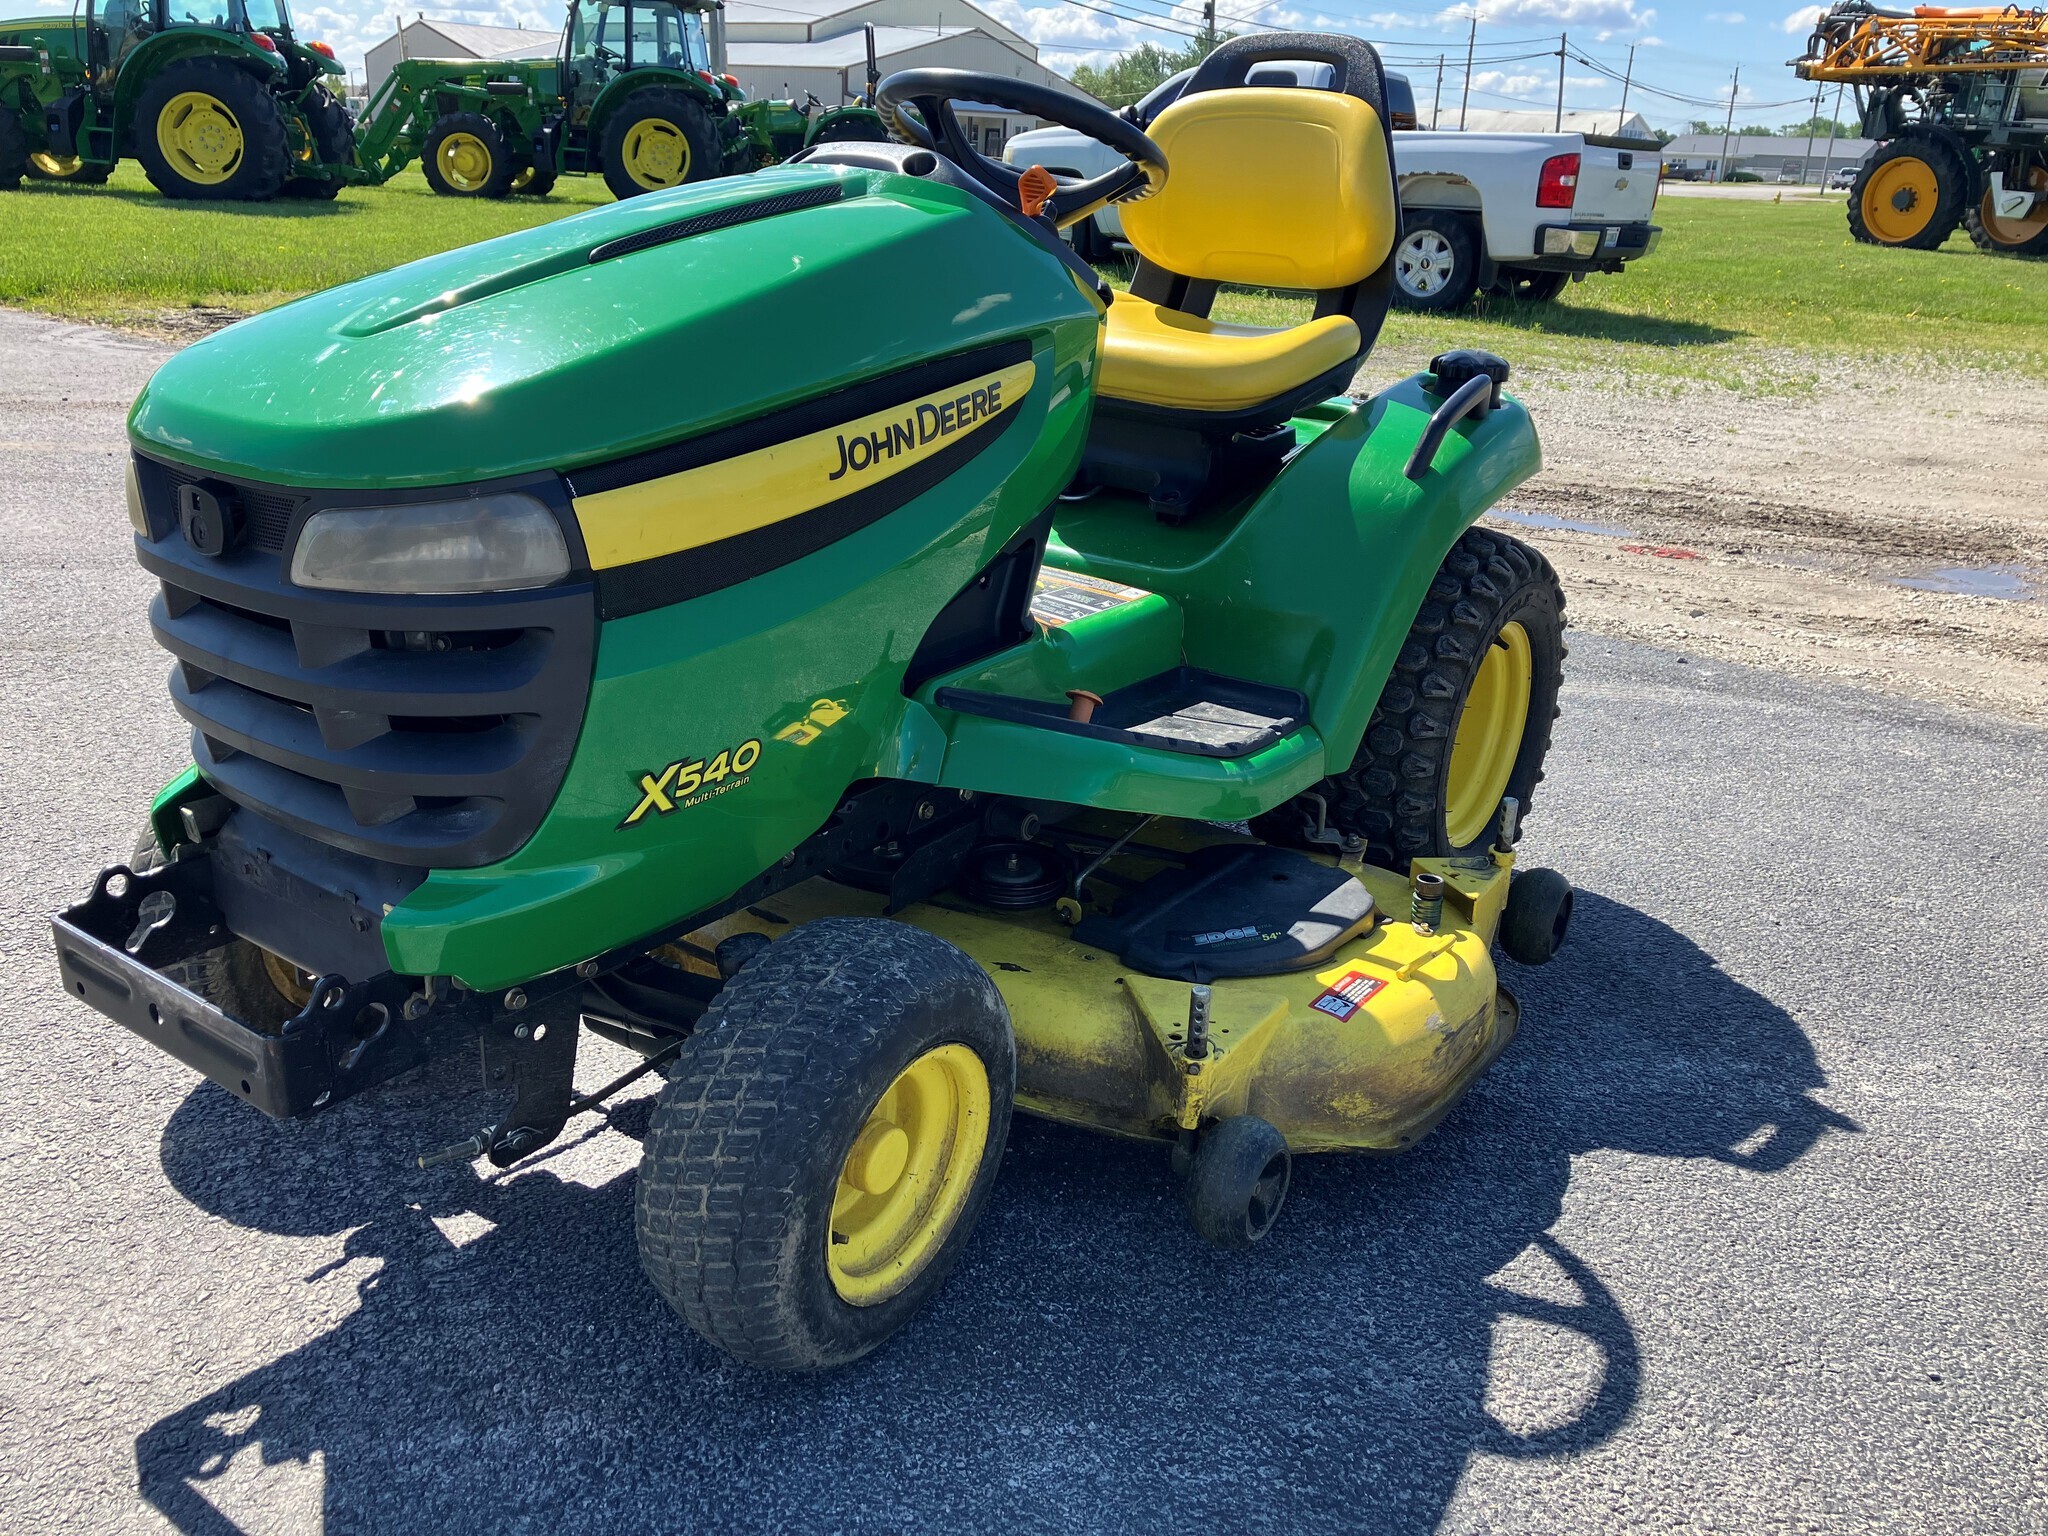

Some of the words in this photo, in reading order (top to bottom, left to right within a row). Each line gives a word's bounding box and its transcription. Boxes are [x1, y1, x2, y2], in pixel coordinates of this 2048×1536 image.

[828, 418, 915, 481] JOHN
[915, 381, 1002, 446] DEERE
[620, 739, 763, 827] X540
[683, 775, 751, 809] Multi-Terrain
[1191, 925, 1259, 946] EDGE
[1261, 931, 1282, 941] 54"
